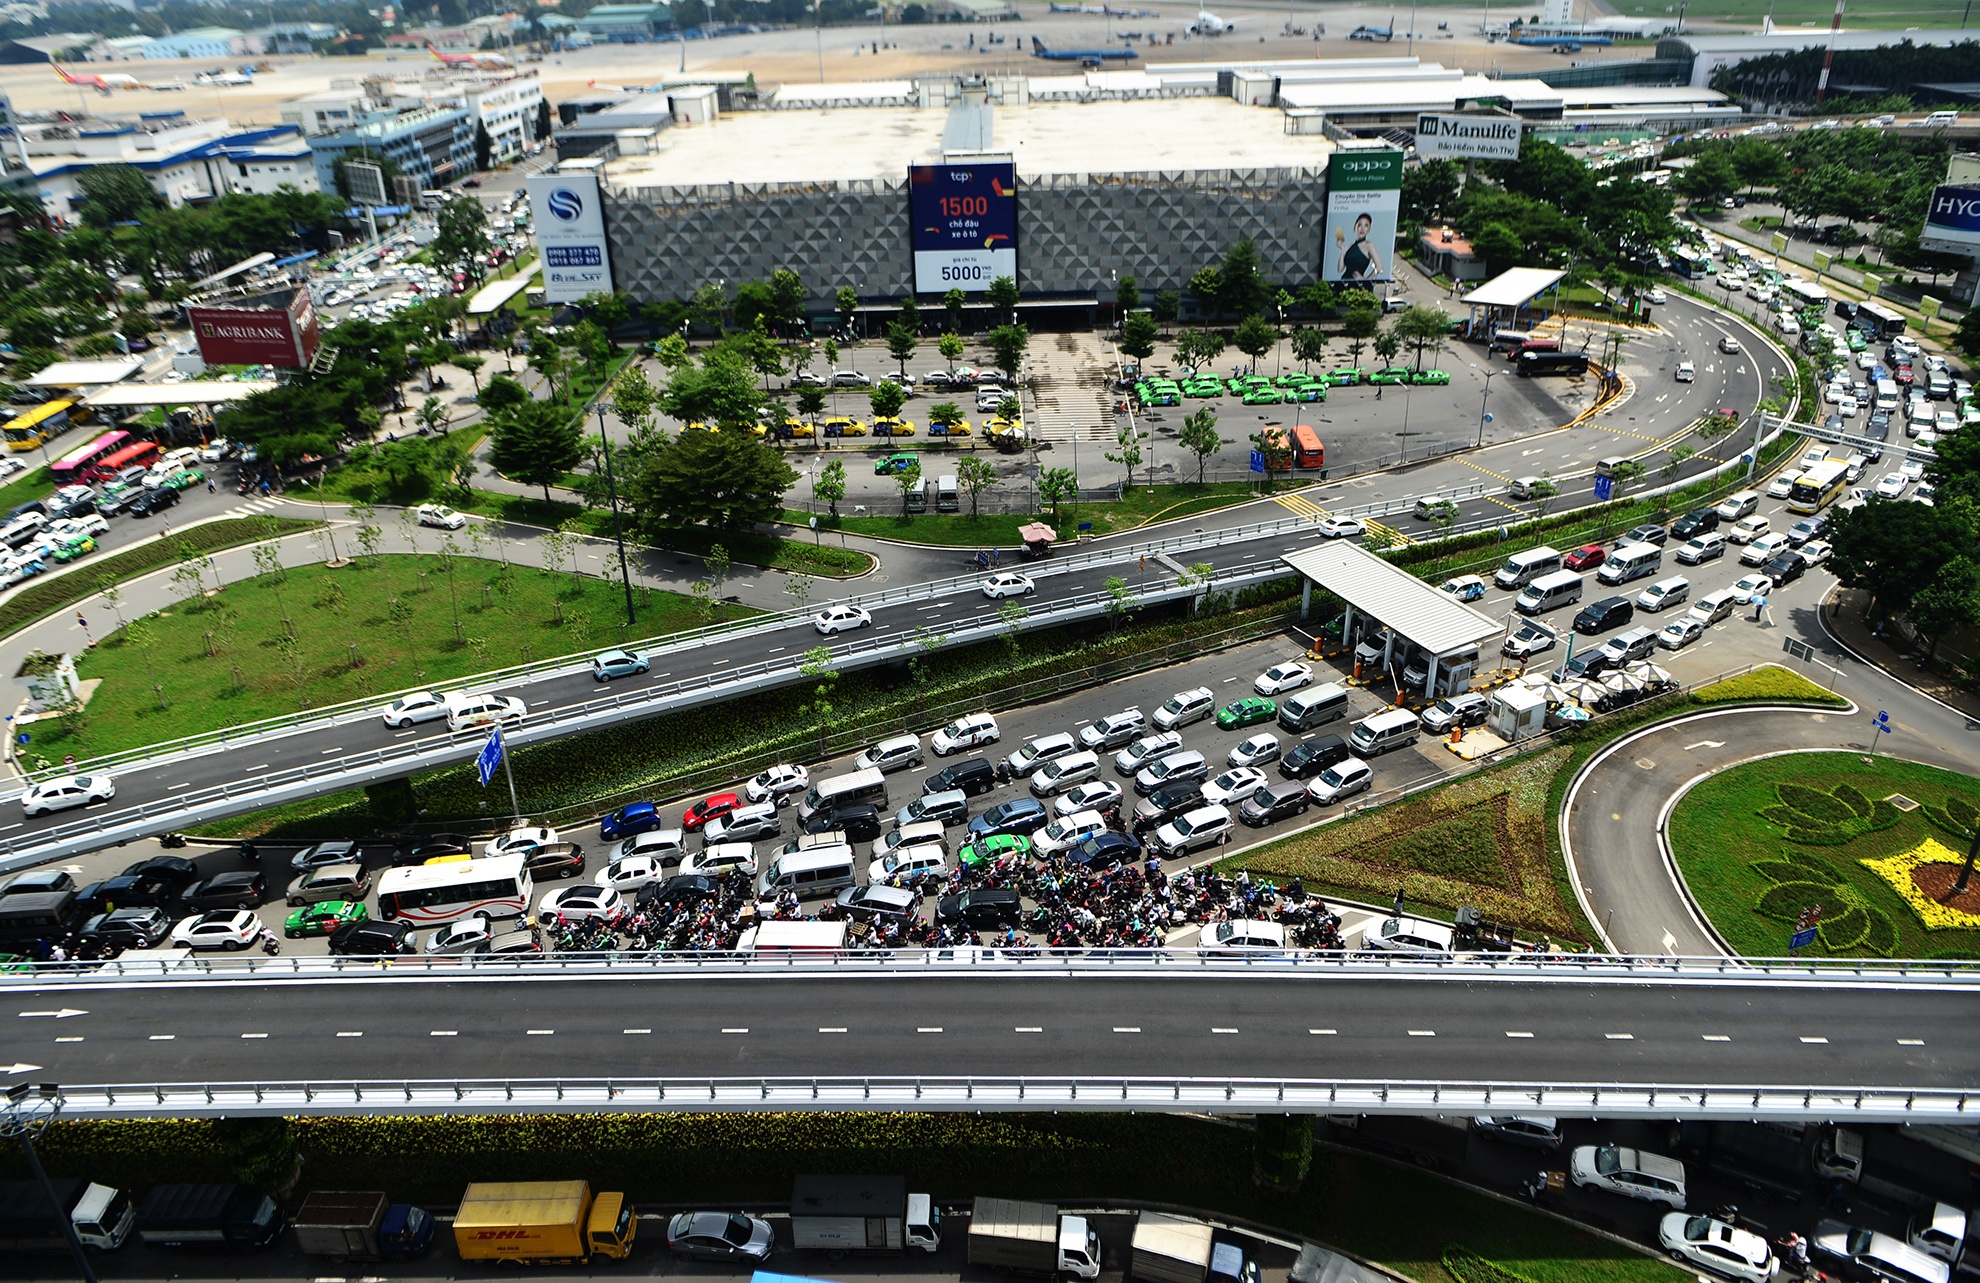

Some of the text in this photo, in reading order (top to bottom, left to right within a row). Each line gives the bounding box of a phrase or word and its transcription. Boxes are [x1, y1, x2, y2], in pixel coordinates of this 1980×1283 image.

[1440, 121, 1517, 140] Manulife
[1477, 144, 1498, 154] Nhân
[951, 172, 968, 183] tcp
[940, 197, 988, 216] 1500
[949, 219, 979, 229] chỗ đậu
[969, 230, 978, 238] tô
[942, 265, 981, 281] 5000
[216, 324, 286, 340] AGRIBANK
[477, 1230, 530, 1240] DHL
